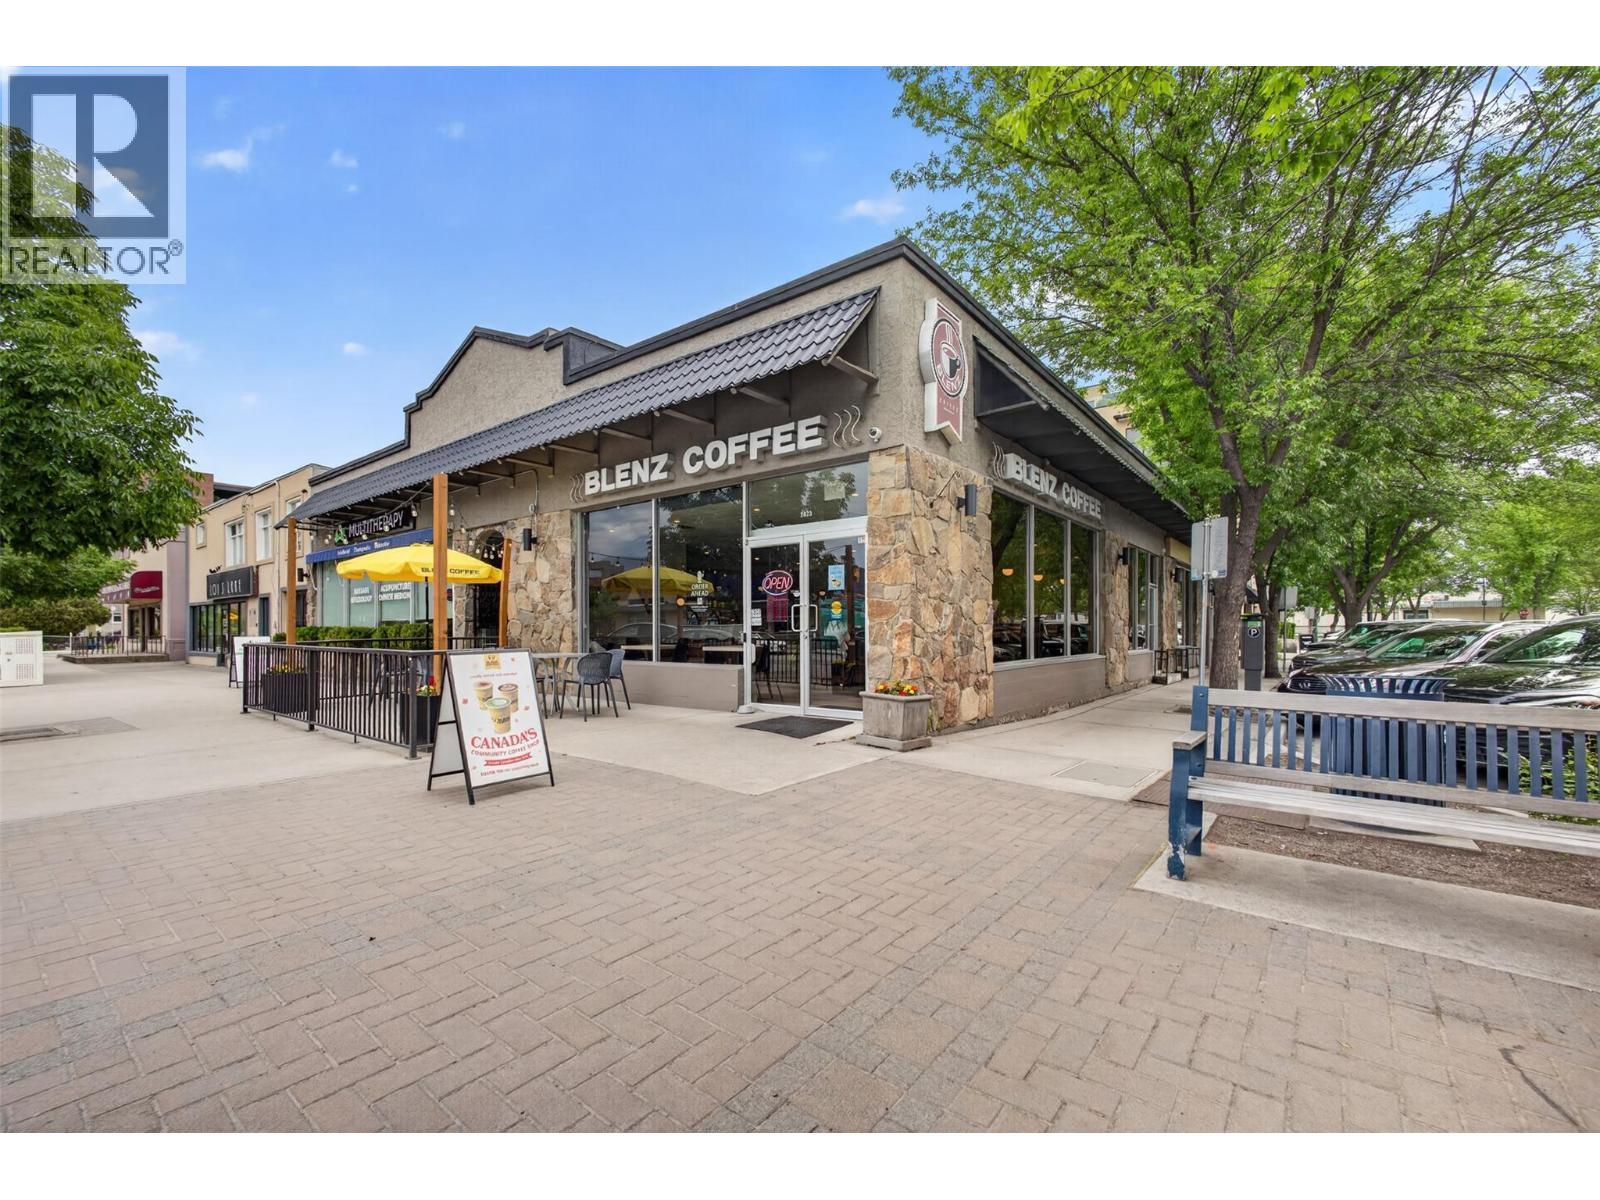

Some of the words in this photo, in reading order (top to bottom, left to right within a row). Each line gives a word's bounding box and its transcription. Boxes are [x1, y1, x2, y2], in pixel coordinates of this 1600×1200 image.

[584, 452, 672, 496] BLENZ
[682, 414, 828, 475] COFFEE
[1004, 453, 1058, 500] BLENZ
[1062, 481, 1102, 519] COFFEE
[348, 510, 404, 538] MULTITHERAPY
[764, 576, 790, 590] OPEN
[471, 728, 538, 749] CANADA'S
[471, 749, 507, 757] COMMUNITY
